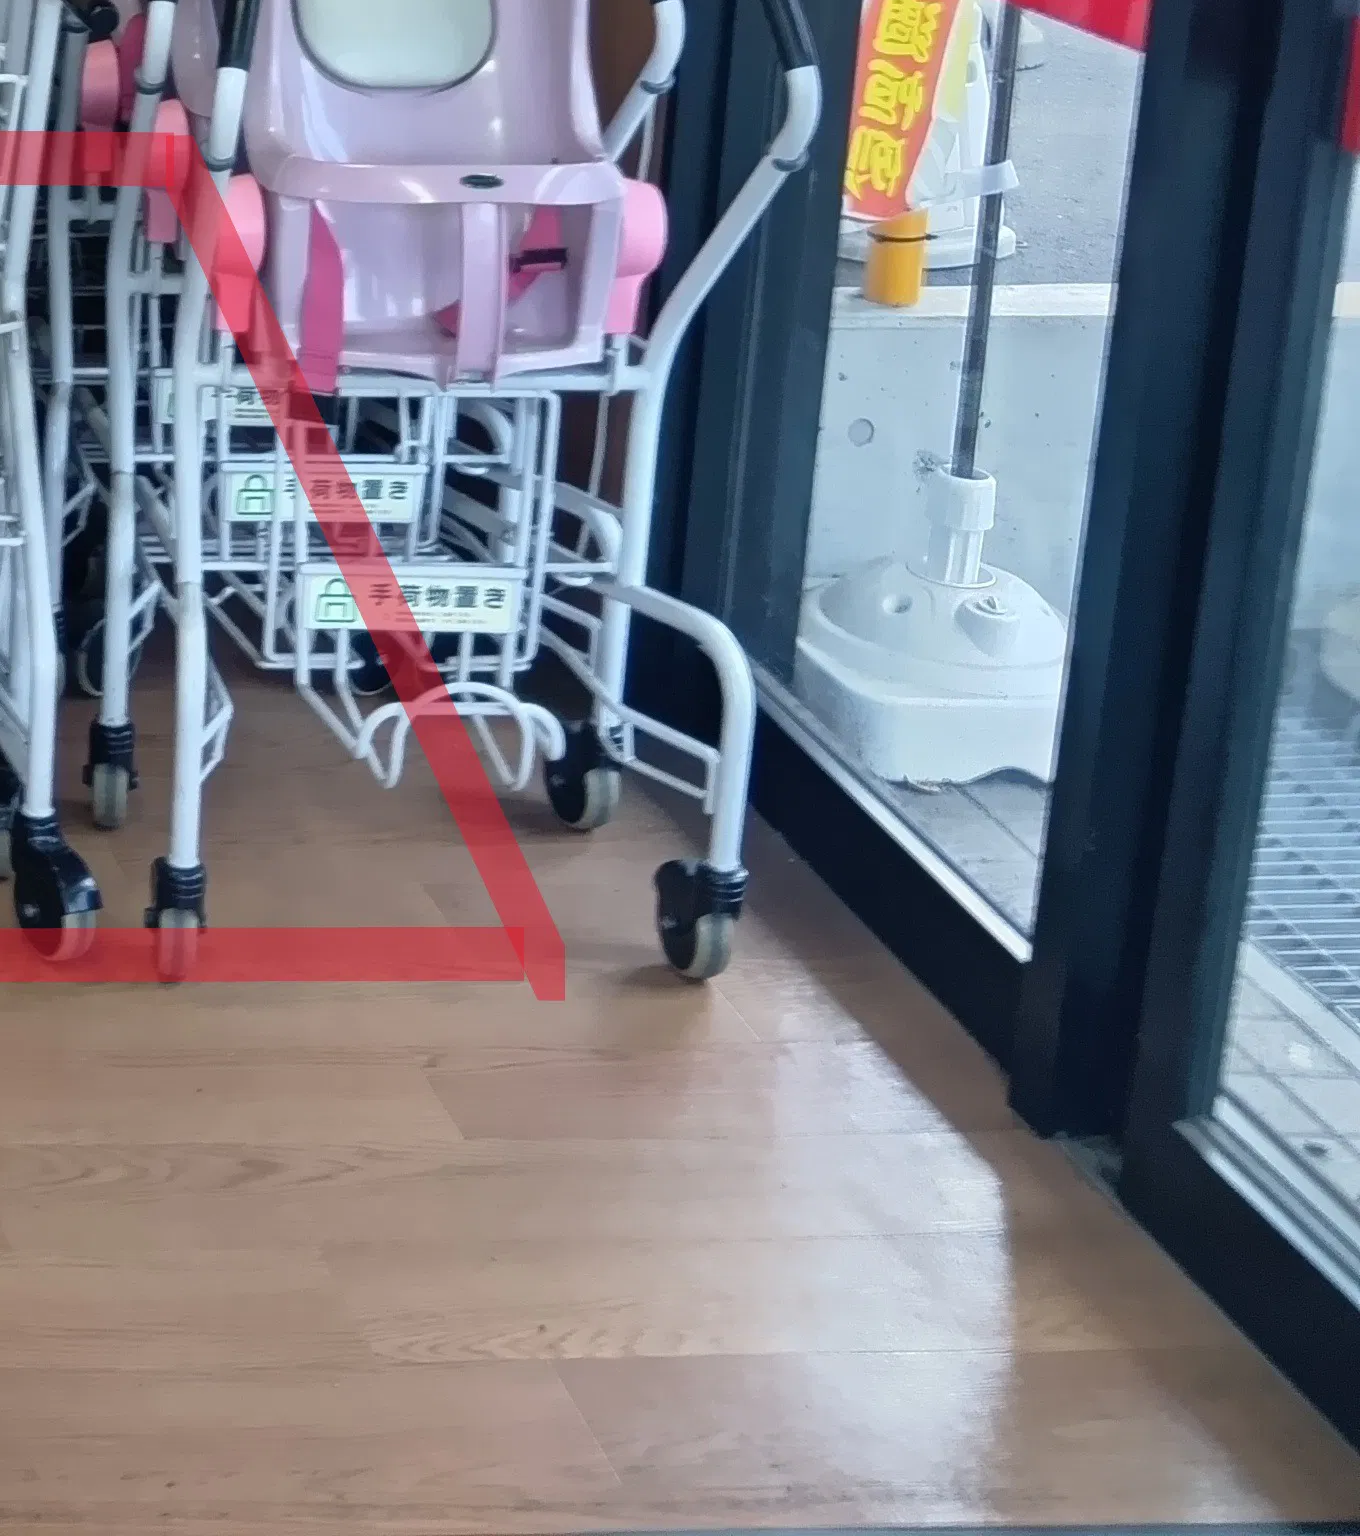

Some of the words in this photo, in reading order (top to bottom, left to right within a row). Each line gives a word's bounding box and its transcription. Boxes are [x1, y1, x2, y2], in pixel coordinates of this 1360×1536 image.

[369, 582, 506, 610] 手荷物置き
